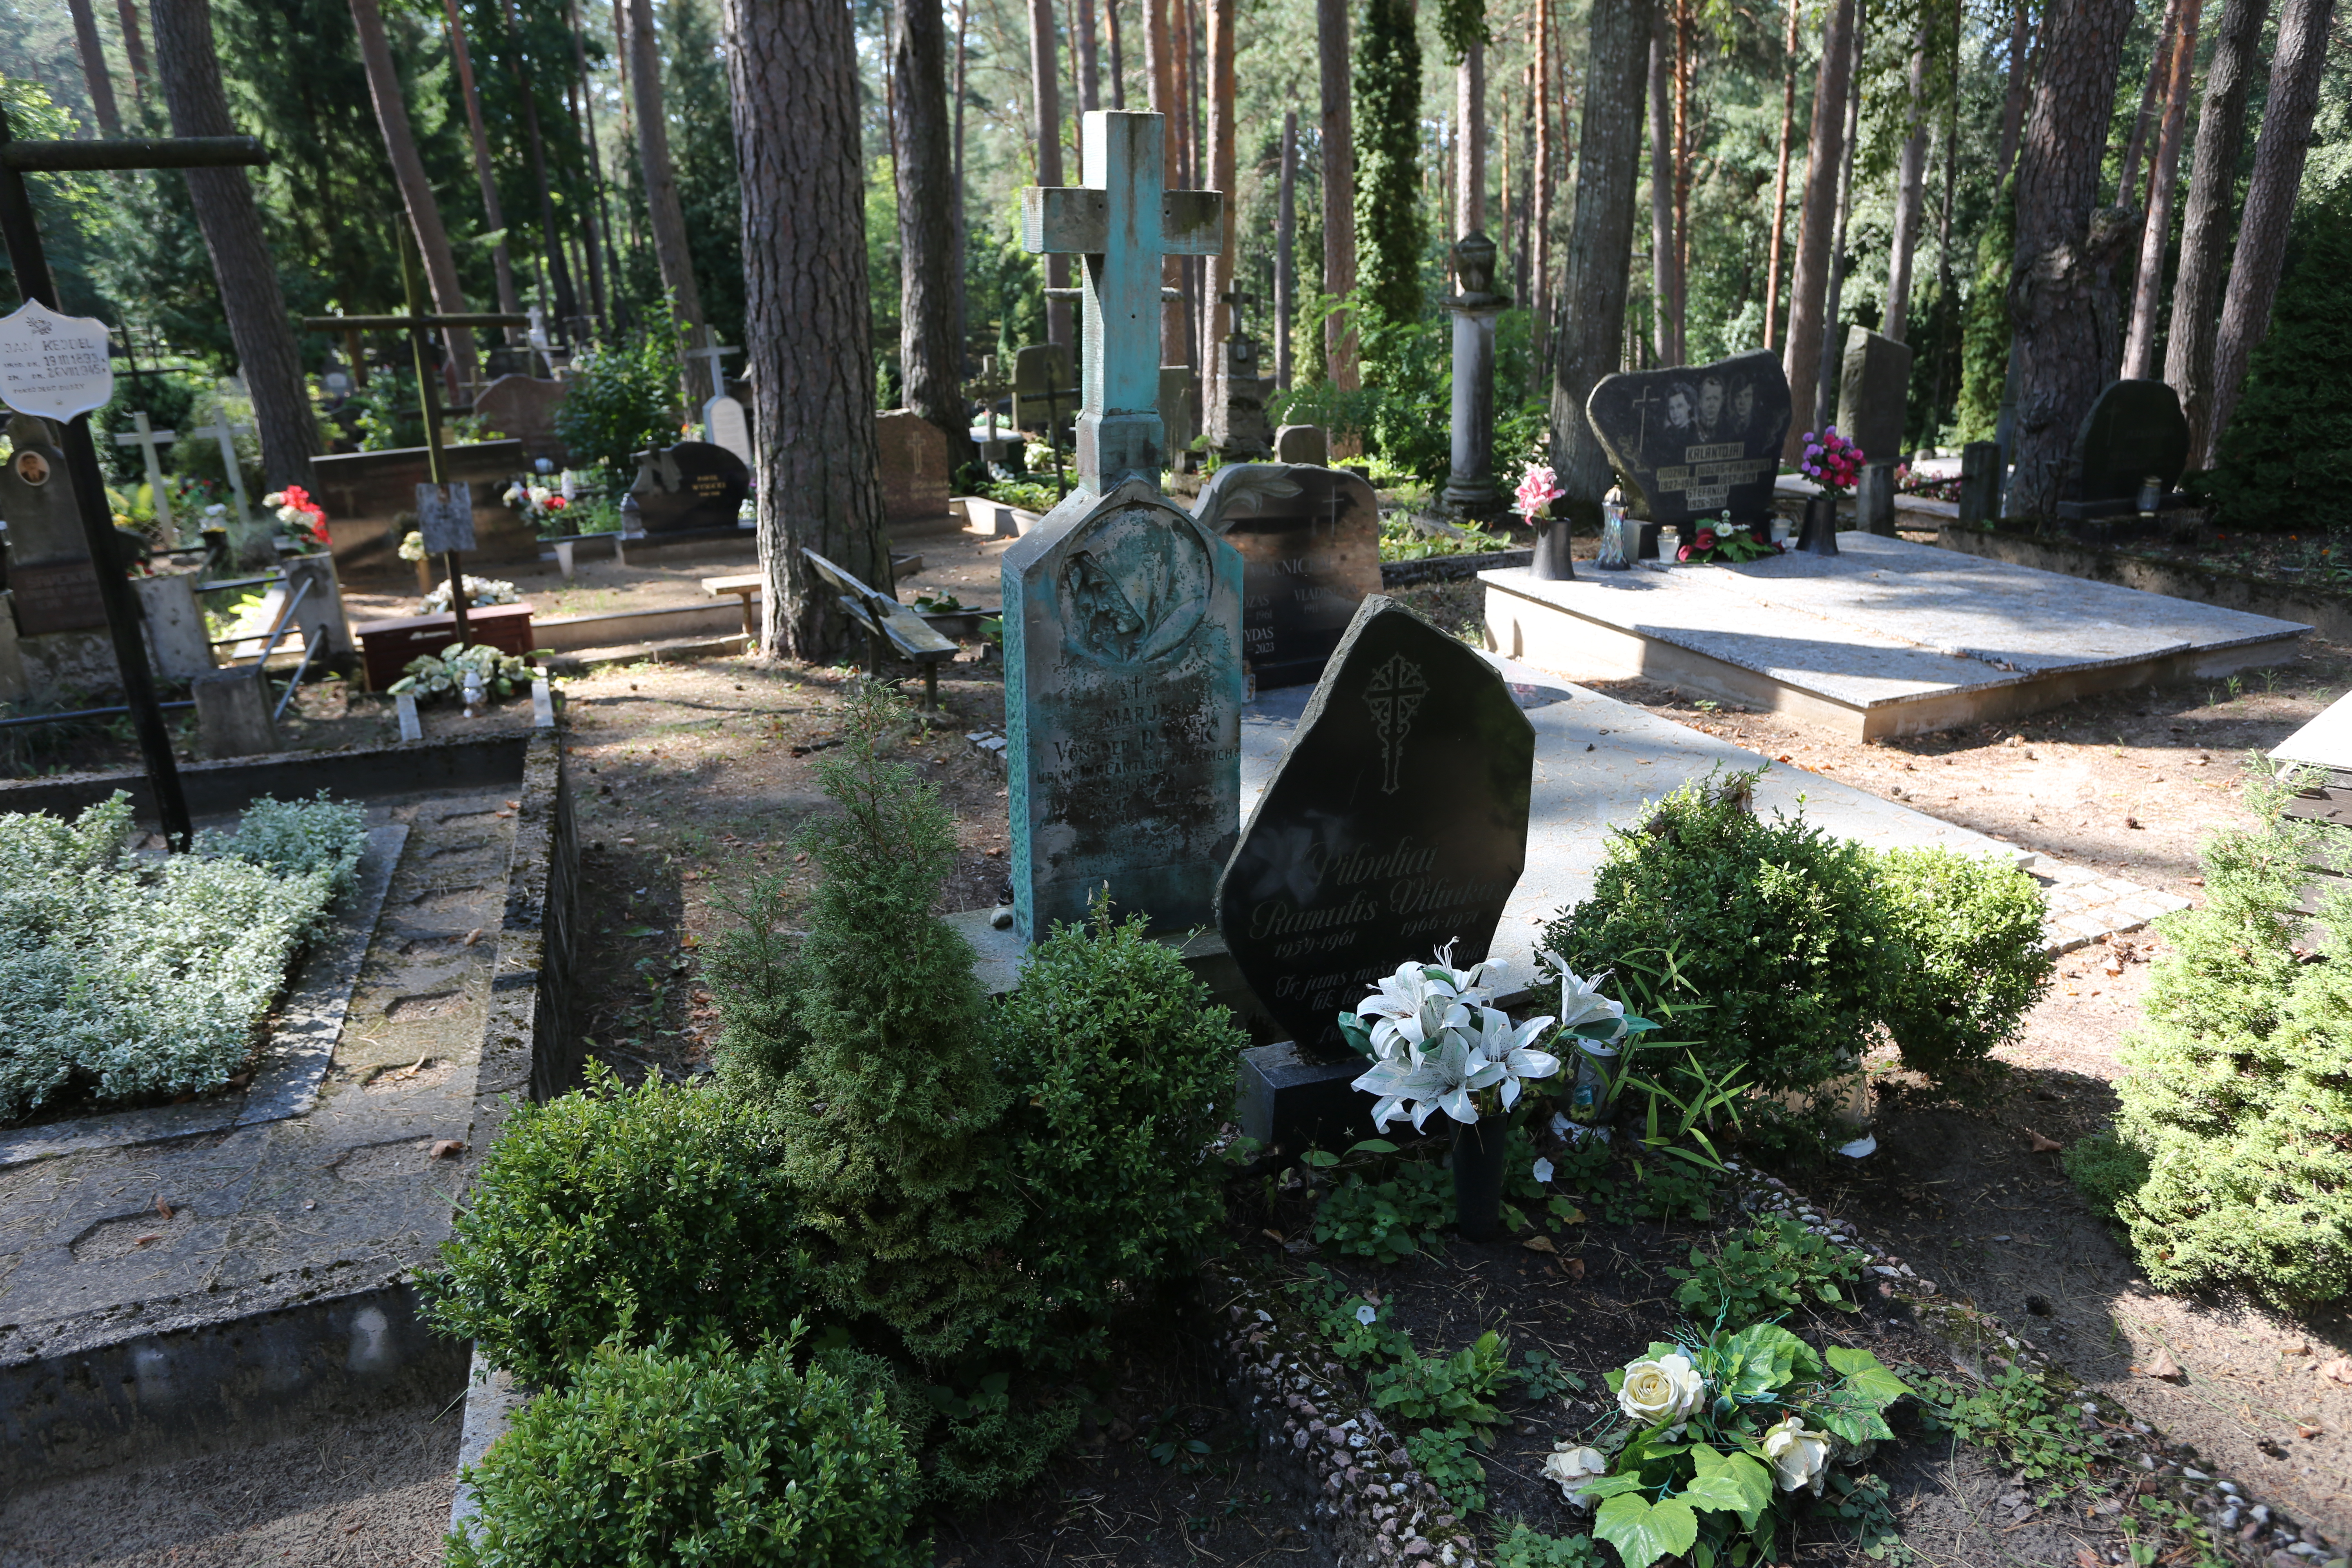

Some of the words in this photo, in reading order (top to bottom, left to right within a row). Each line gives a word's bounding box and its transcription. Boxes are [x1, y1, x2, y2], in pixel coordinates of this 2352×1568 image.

[4, 341, 33, 353] JAN
[1688, 443, 1742, 460] KALANTOJAI
[1659, 468, 1687, 478] JUOZAS
[1661, 477, 1697, 489] 1927-1961
[1688, 485, 1728, 498] STEFANIJA
[1256, 609, 1272, 620] 1961
[1255, 642, 1274, 654] 2023
[1299, 835, 1439, 892] Pilveliai
[1249, 890, 1379, 939] Ramutis
[1390, 875, 1507, 915] Viliukas
[1295, 972, 1348, 1001] jums
[1312, 989, 1336, 1011] tik
